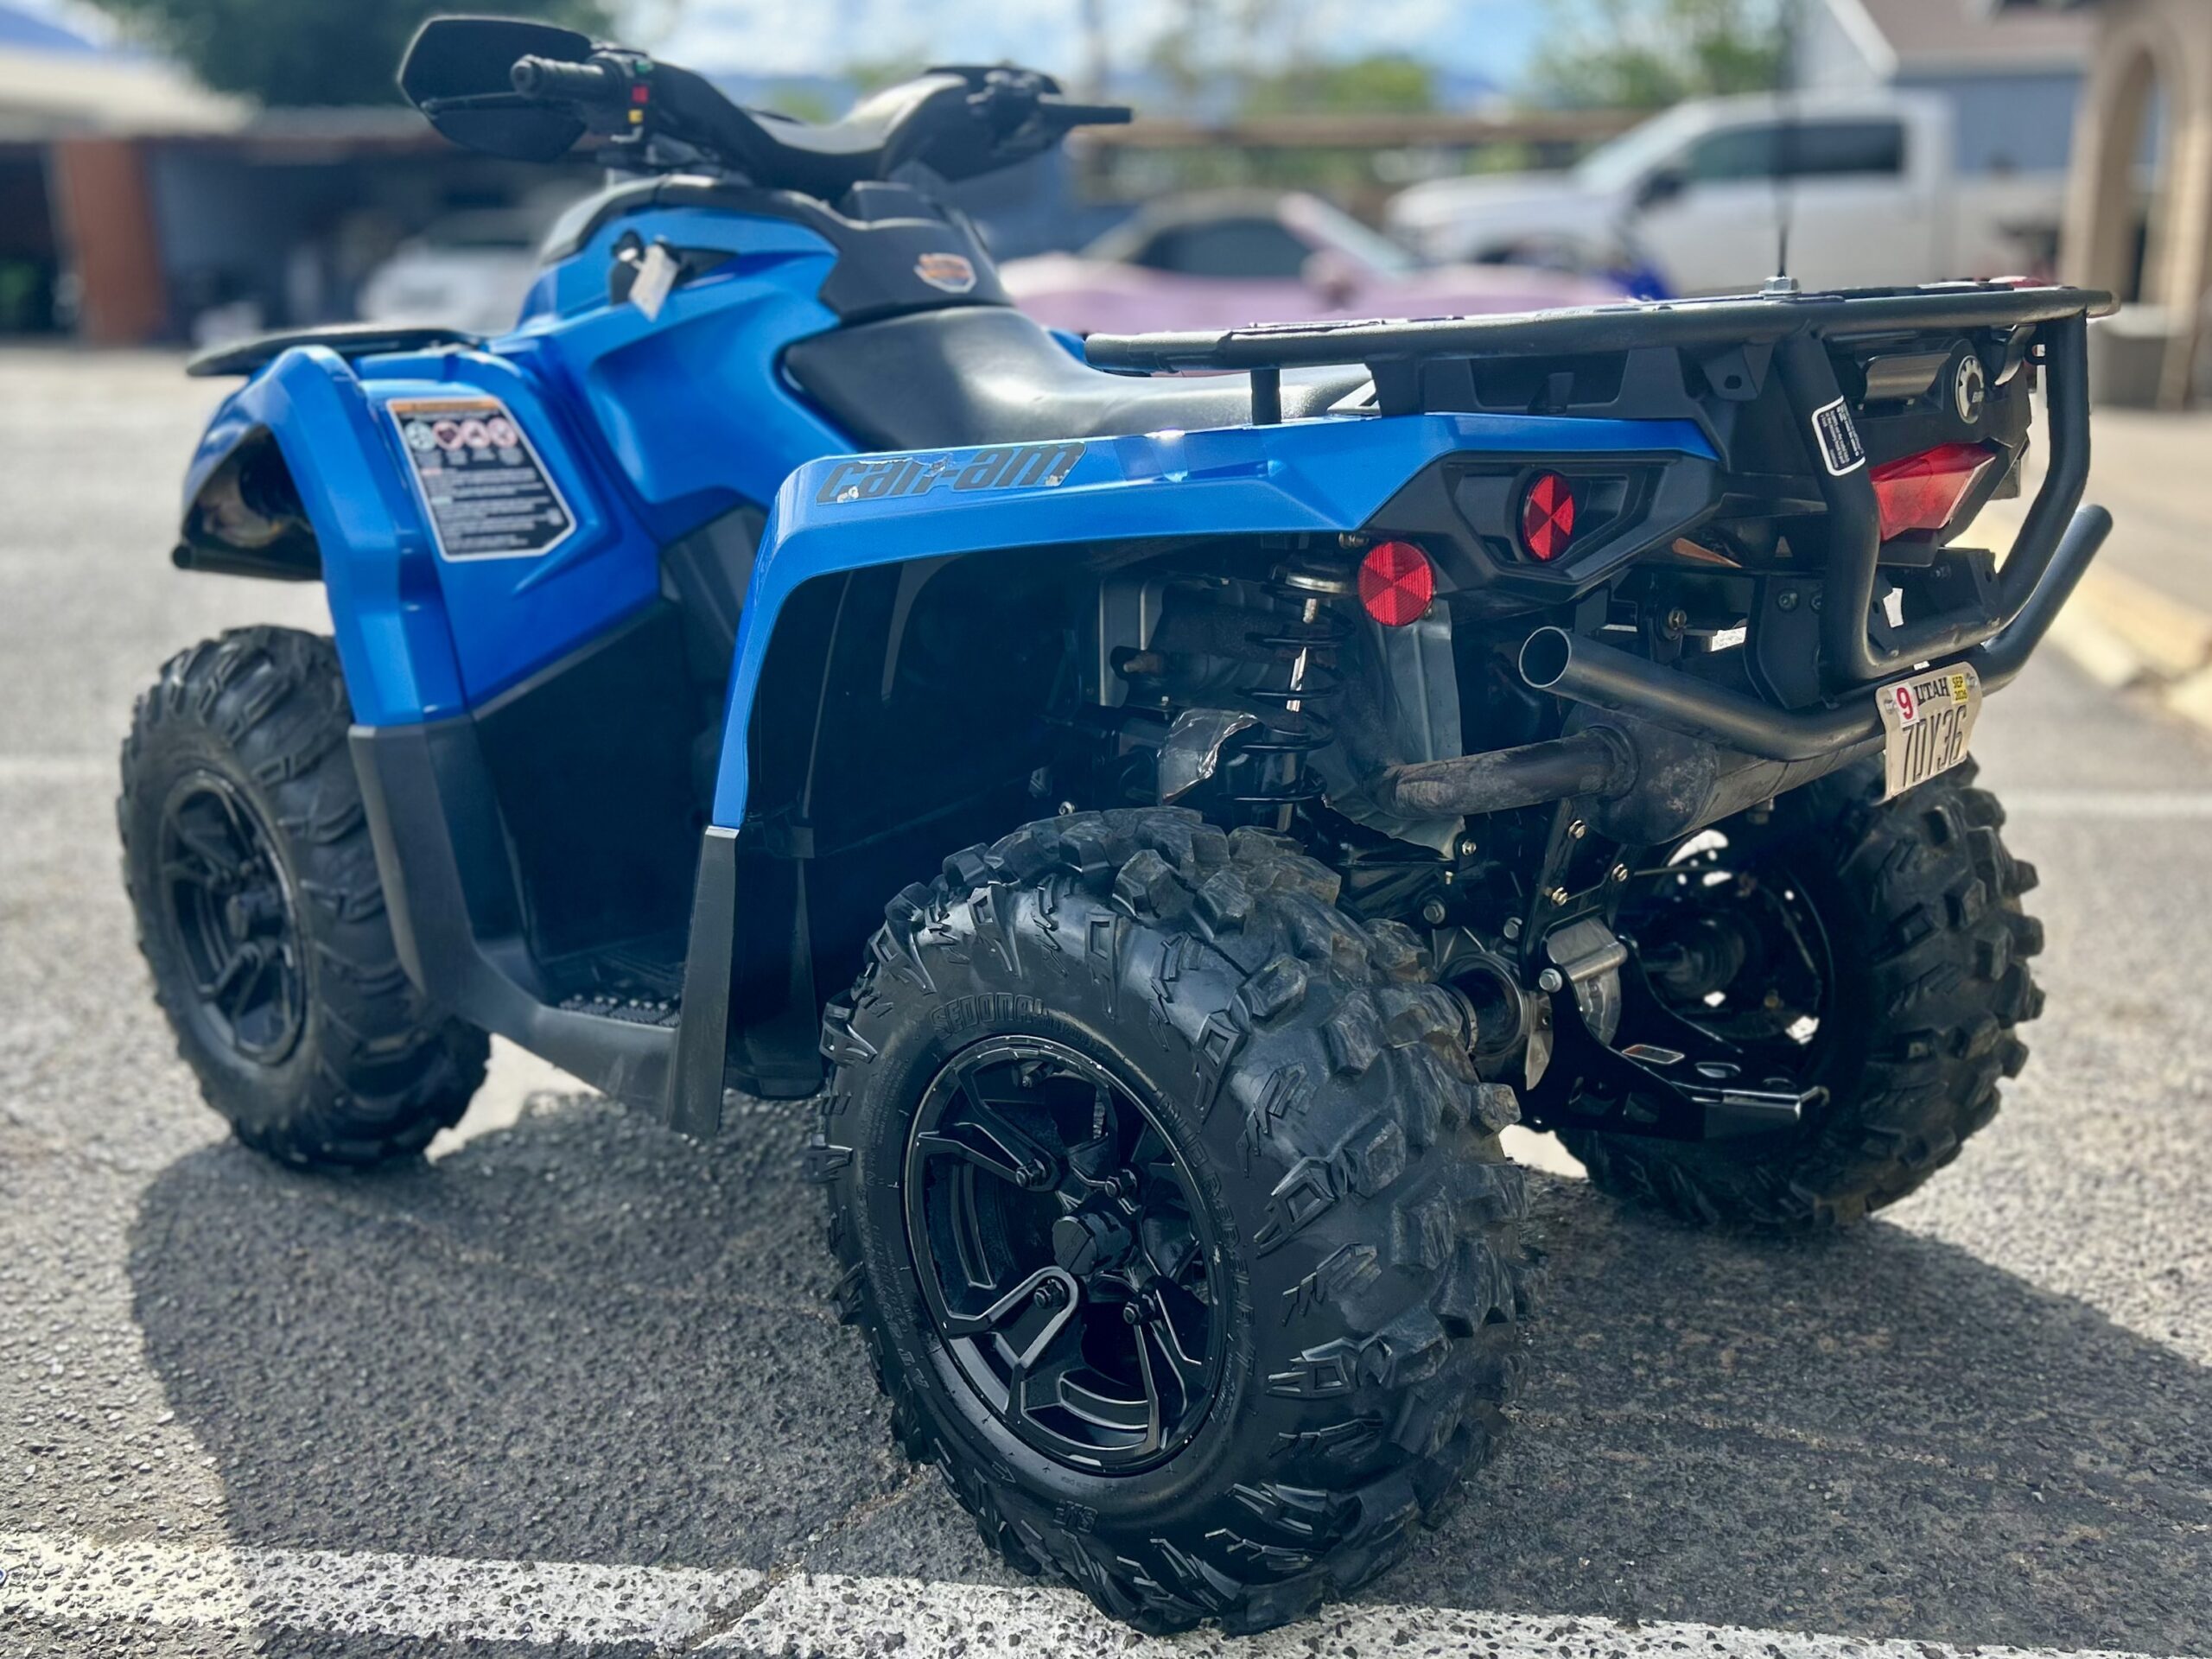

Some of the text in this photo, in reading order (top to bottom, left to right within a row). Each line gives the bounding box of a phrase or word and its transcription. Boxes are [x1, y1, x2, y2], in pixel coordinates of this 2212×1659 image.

[1897, 677, 1950, 720] 9 UTAH
[1952, 676, 1963, 689] SEP
[930, 992, 1034, 1040] SEDONA
